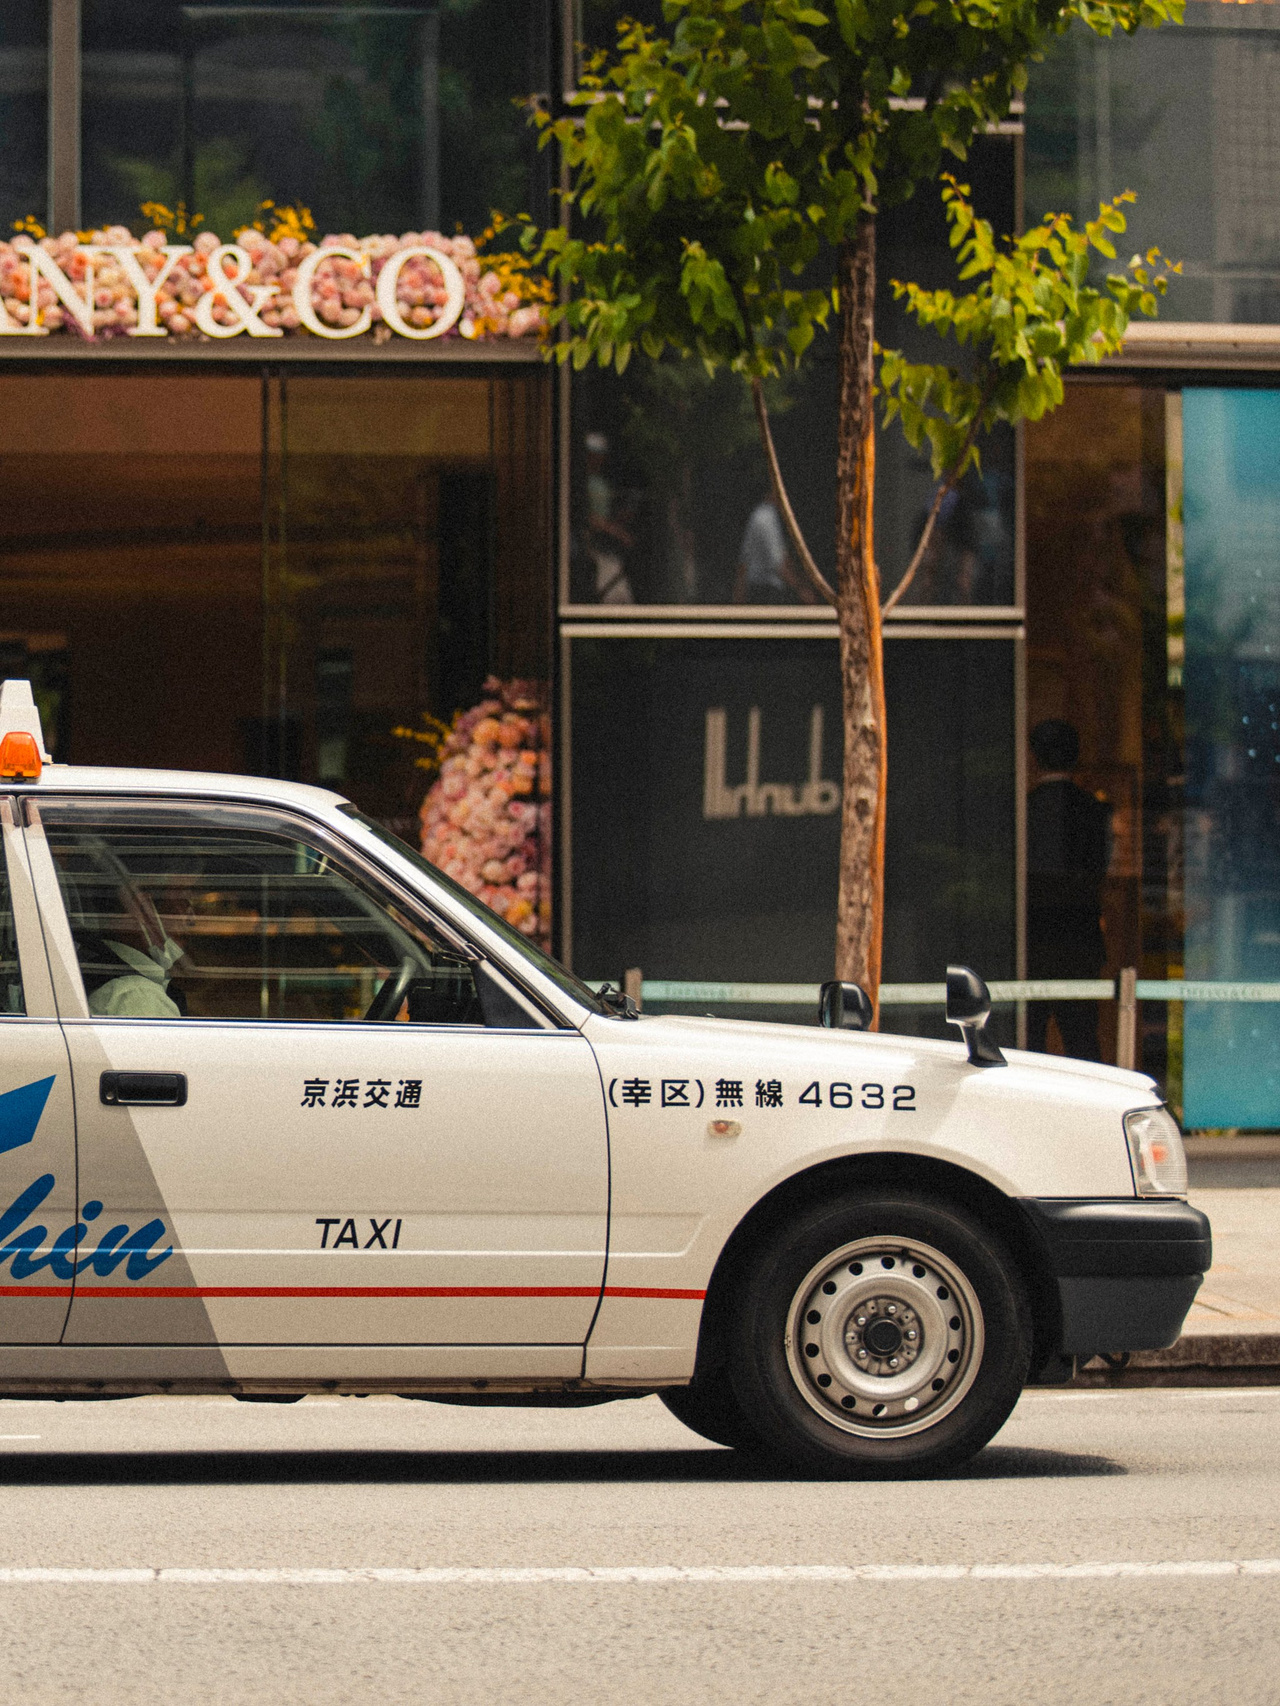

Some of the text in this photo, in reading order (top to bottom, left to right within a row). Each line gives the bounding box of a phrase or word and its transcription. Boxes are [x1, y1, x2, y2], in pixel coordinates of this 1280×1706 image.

[300, 1077, 423, 1109] 京浜交通
[798, 1080, 917, 1112] 4632
[315, 1218, 402, 1249] TAXI
